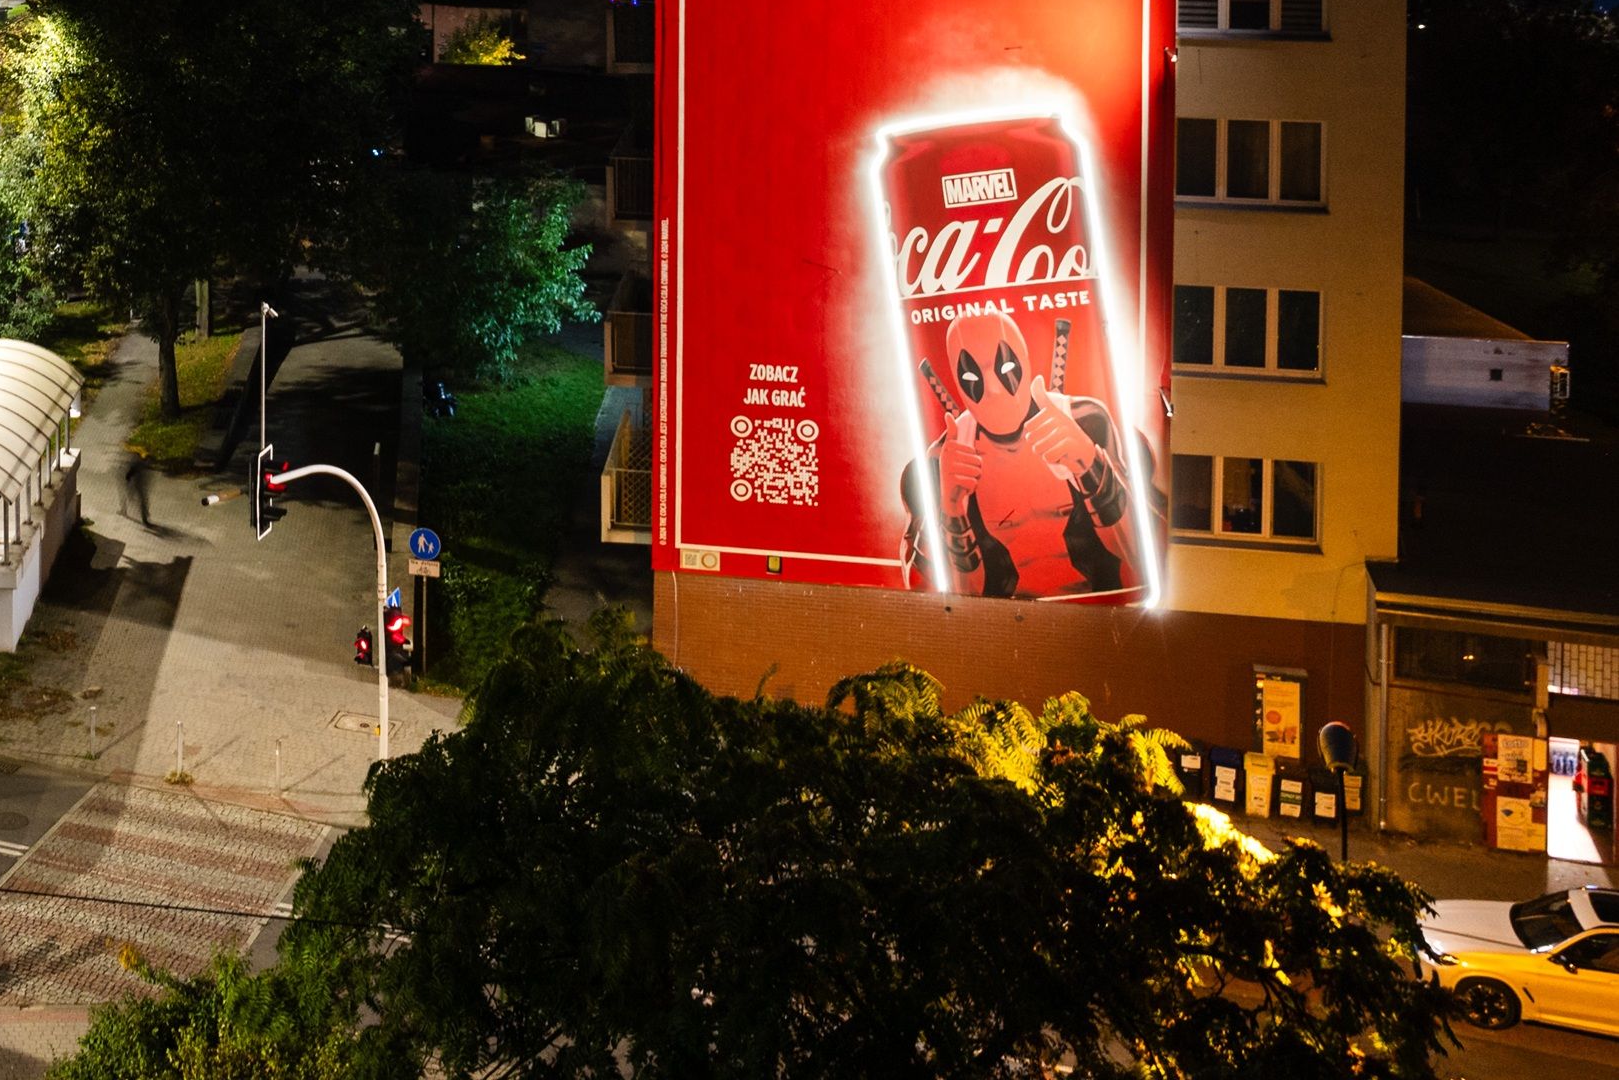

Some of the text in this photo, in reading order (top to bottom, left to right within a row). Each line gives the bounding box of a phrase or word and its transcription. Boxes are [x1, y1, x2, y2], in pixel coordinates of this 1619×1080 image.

[945, 172, 1014, 205] MARVEL
[910, 290, 1091, 325] ORIGINAL TASTE
[749, 363, 799, 383] ZOBACZ
[743, 386, 806, 408] JAK GRAĆ
